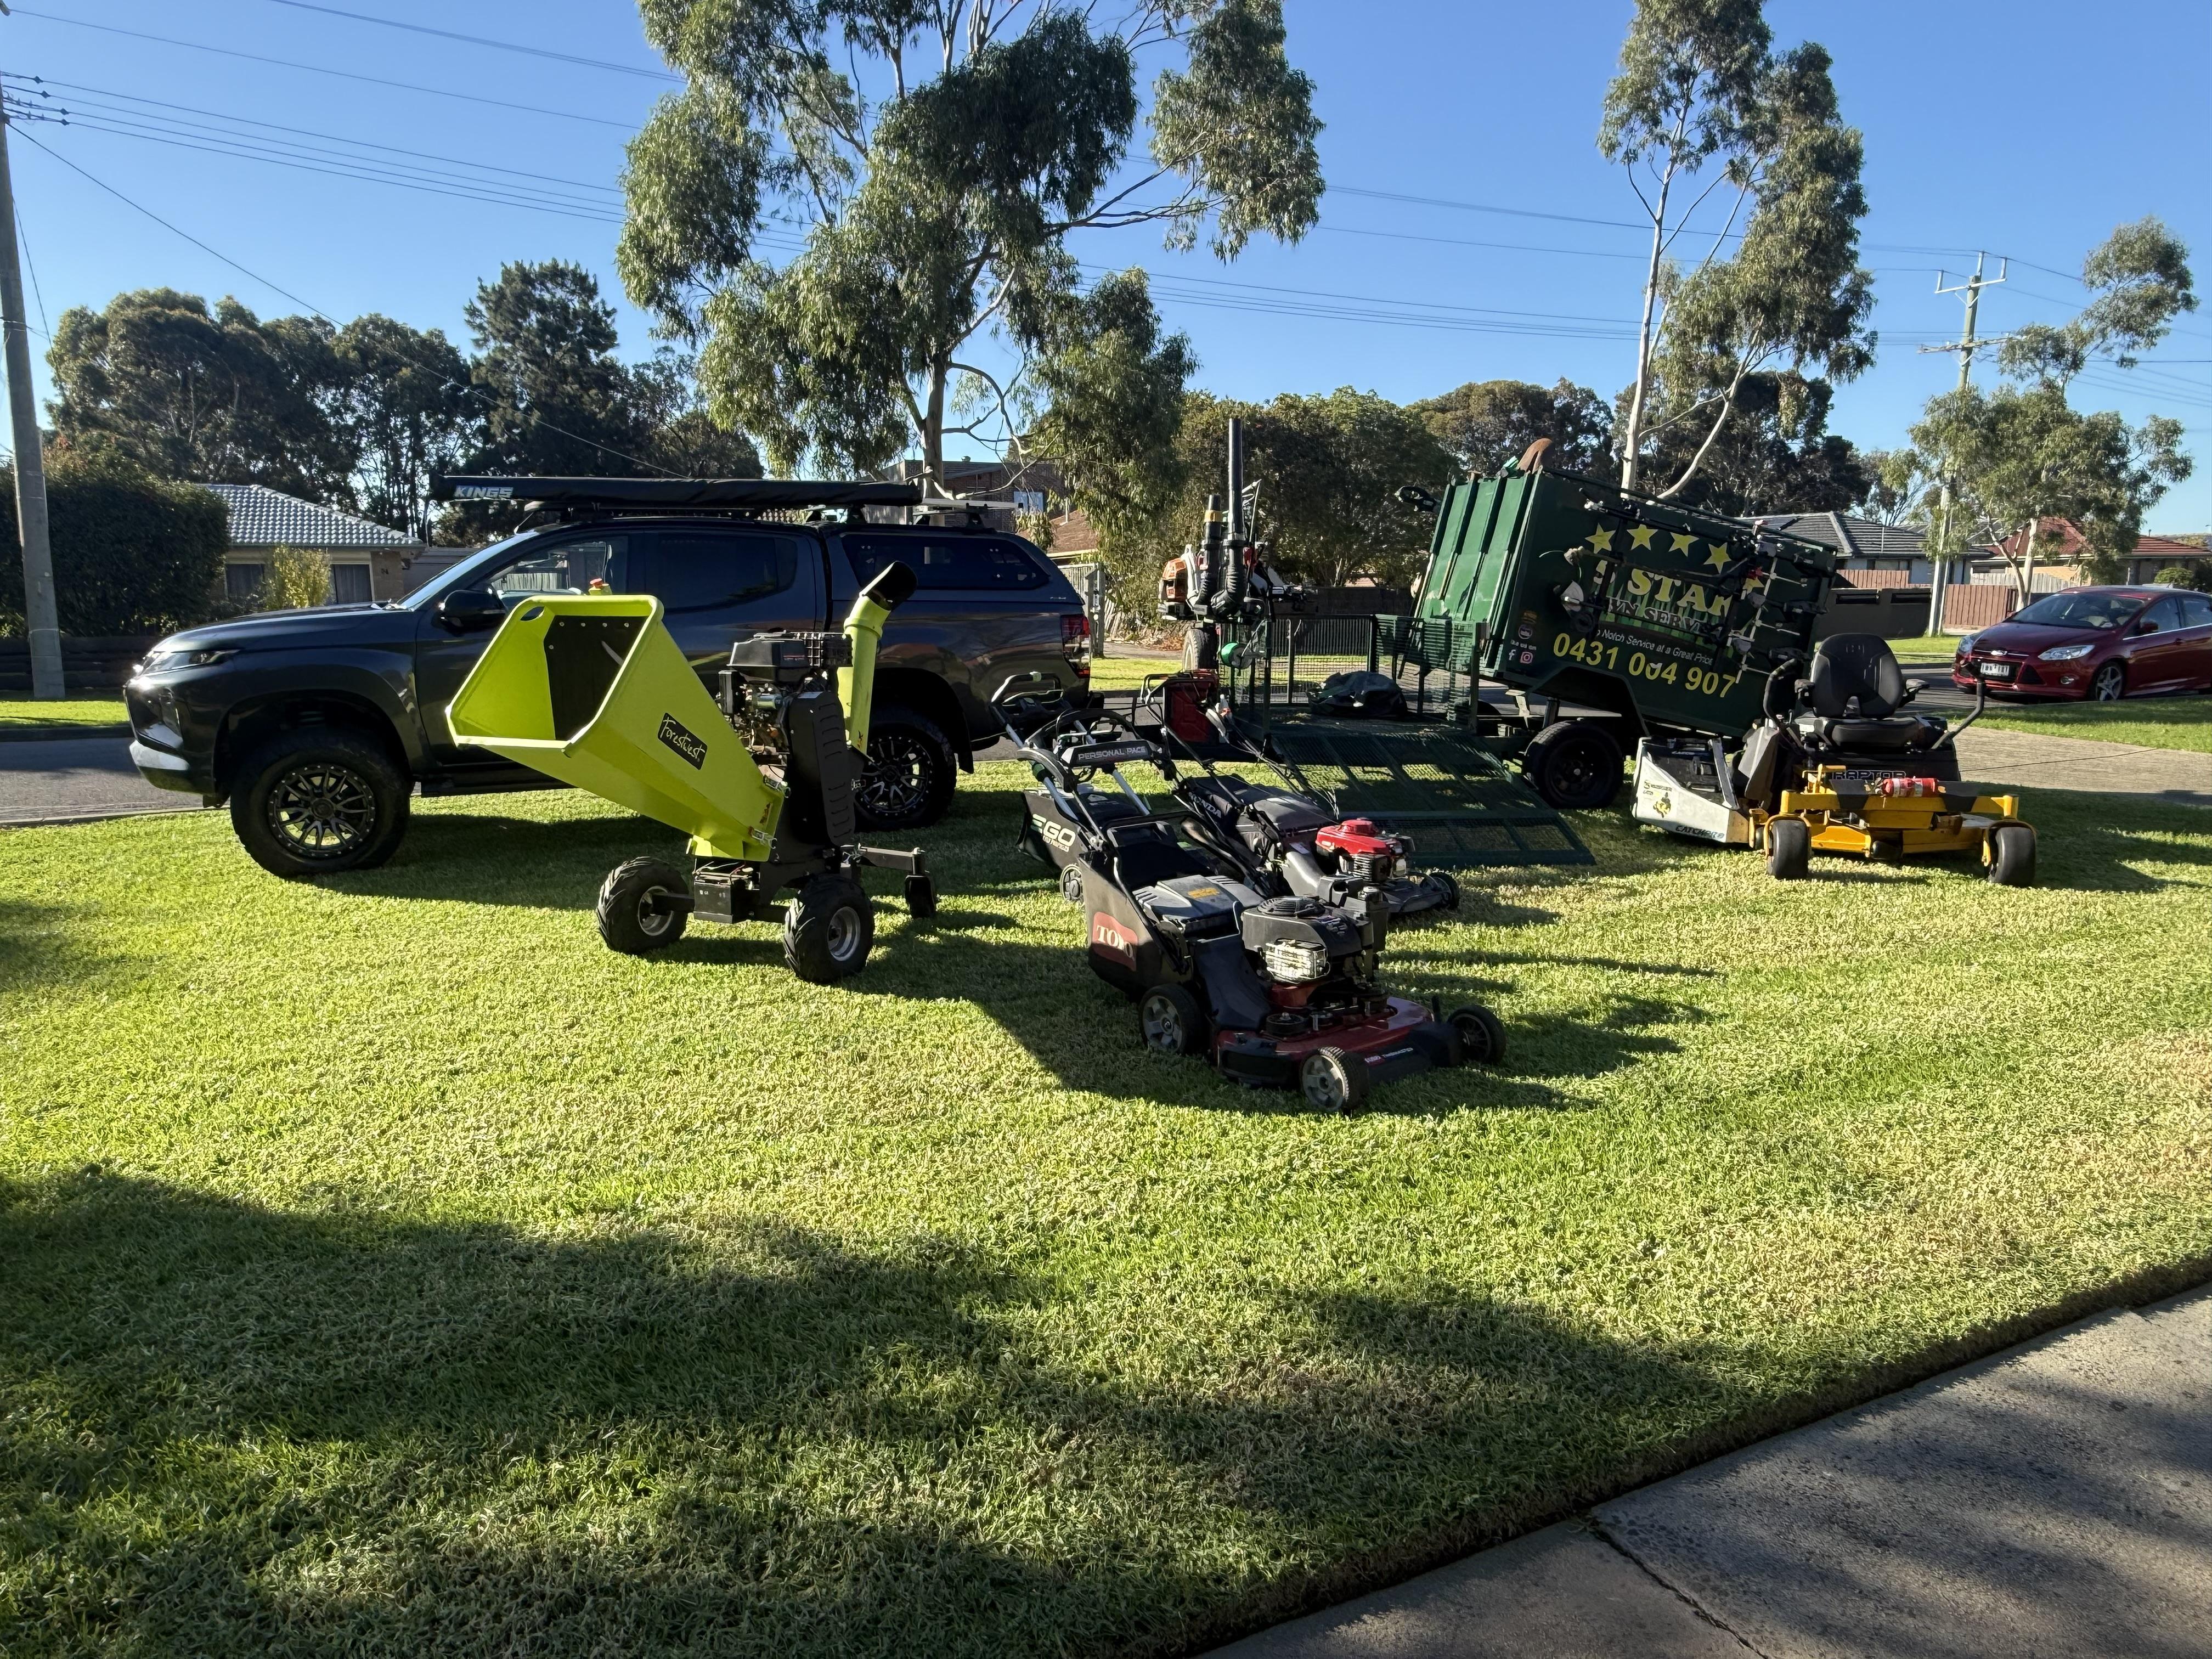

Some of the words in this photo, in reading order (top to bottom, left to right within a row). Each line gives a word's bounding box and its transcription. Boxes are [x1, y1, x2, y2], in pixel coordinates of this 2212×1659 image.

[454, 486, 514, 498] KINGS
[1626, 635, 1655, 650] Service
[1673, 647, 1694, 661] Great
[1553, 633, 1618, 670] 0431
[1685, 667, 1736, 698] 907
[1078, 749, 1125, 760] PERSONAL
[1126, 746, 1146, 754] PACE
[1030, 814, 1076, 847] EGO
